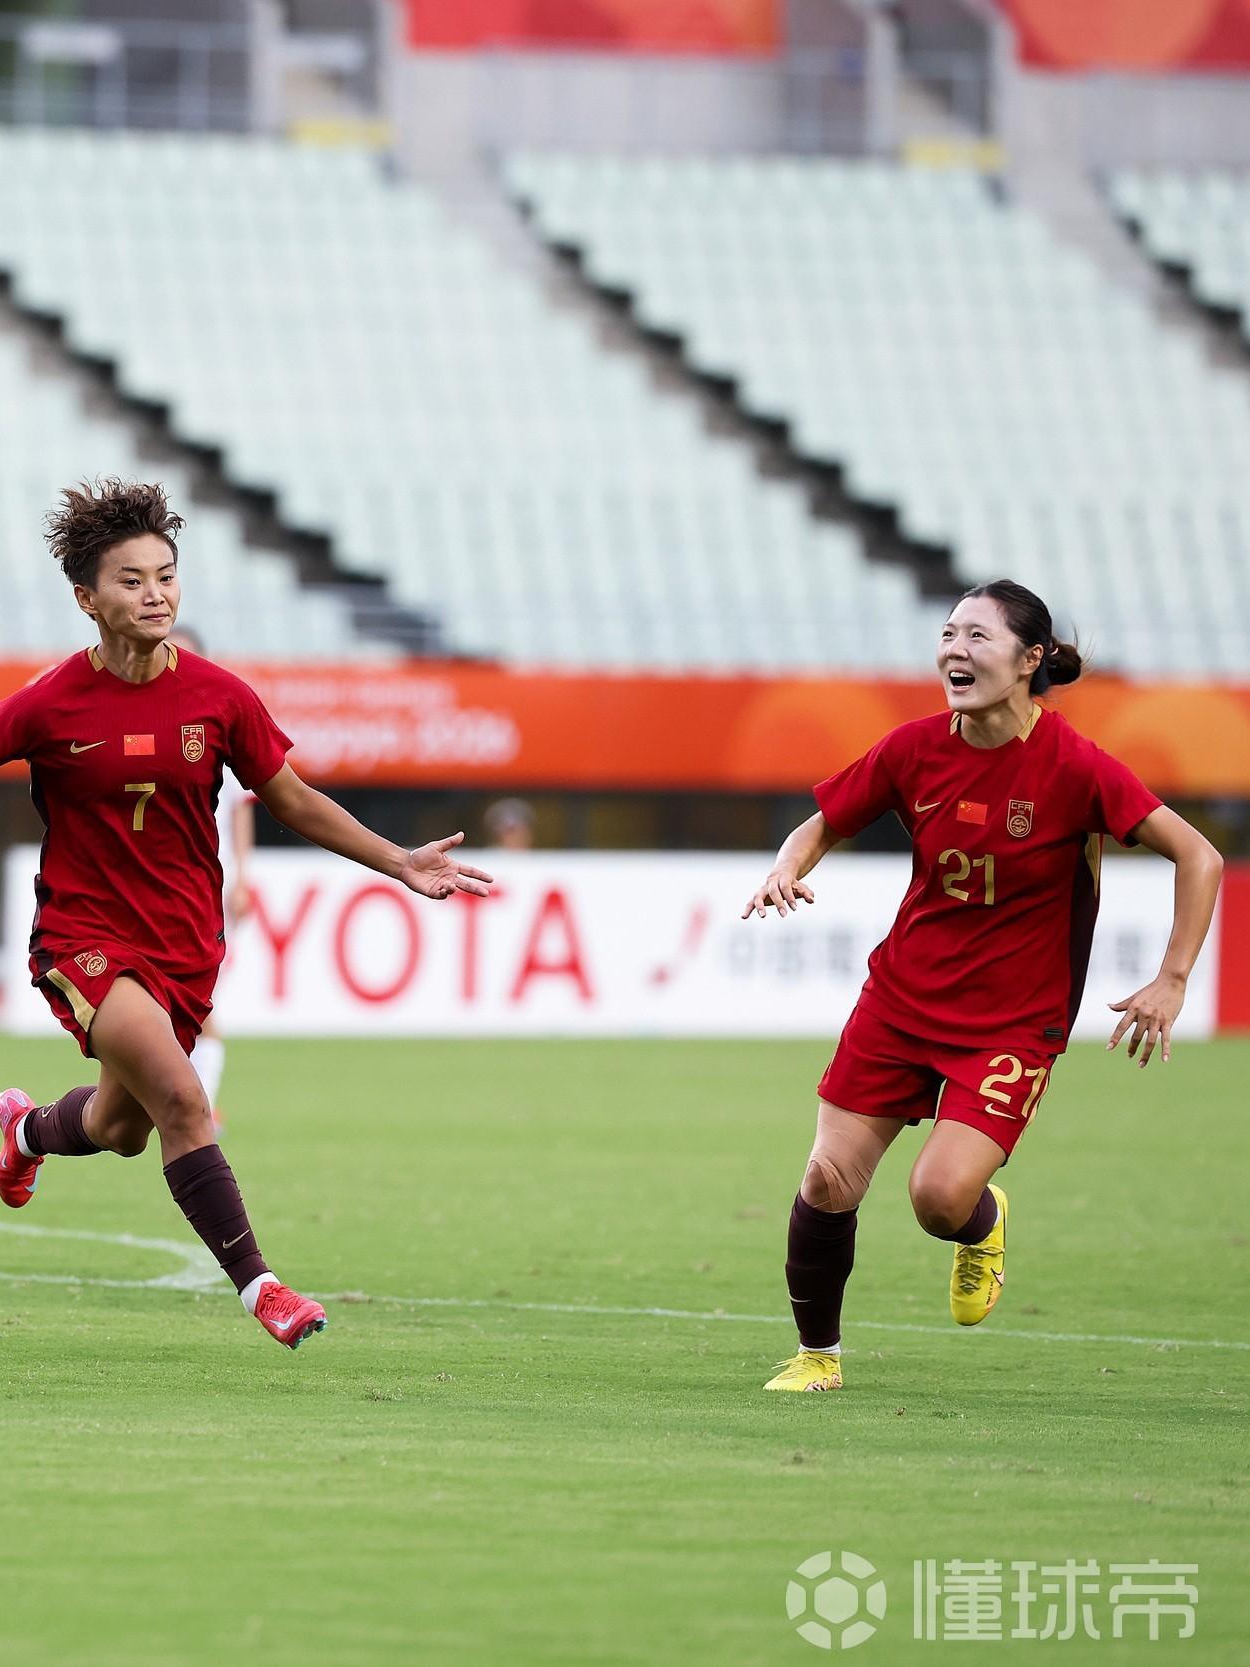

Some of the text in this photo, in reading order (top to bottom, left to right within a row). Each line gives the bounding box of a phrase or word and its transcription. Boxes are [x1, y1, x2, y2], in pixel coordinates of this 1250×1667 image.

[124, 783, 156, 831] 7
[1011, 802, 1031, 811] CFA
[938, 848, 995, 905] 21
[228, 883, 595, 1005] YOTA
[979, 1055, 1047, 1118] 21
